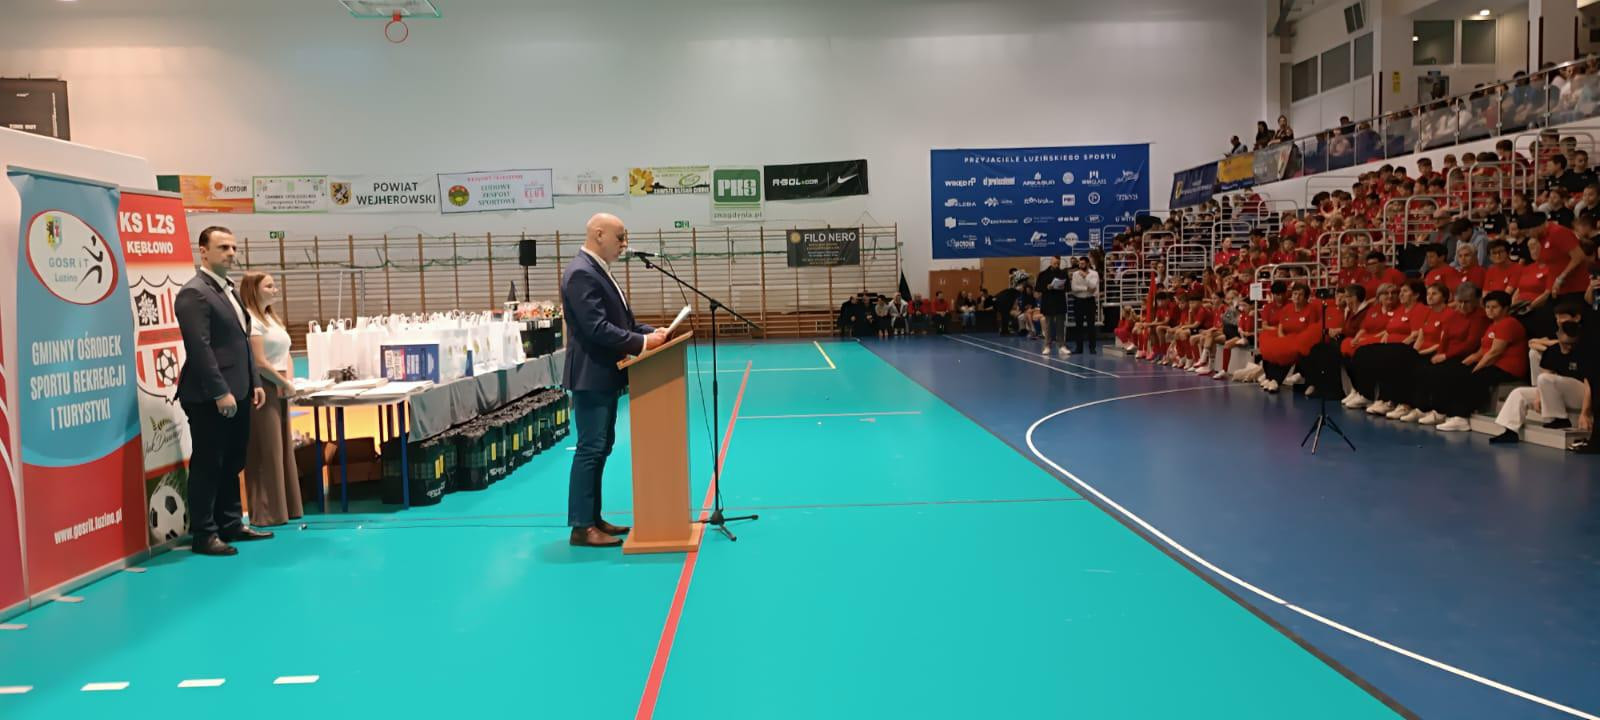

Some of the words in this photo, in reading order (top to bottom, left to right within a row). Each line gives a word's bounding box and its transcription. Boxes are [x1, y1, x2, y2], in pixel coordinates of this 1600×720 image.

[964, 156, 1020, 164] PRZYJACIELE
[1083, 152, 1117, 160] SPORTU
[373, 182, 418, 192] POWIAT
[577, 183, 605, 193] KLUB
[717, 178, 757, 197] PKS
[356, 194, 436, 205] WEJHEROWSKI
[119, 211, 143, 233] KS
[147, 213, 175, 235] LZS
[804, 233, 826, 243] FILO
[828, 231, 857, 242] NERO
[126, 240, 174, 256] KĘBŁOWO
[48, 257, 76, 268] GOSR
[83, 258, 89, 268] T
[54, 273, 78, 283] Luzino
[32, 339, 75, 366] GMINNY
[77, 331, 122, 360] OŚRODEK
[30, 372, 71, 400] SPORTU
[73, 365, 127, 394] REKREACJI
[51, 407, 55, 431] I
[57, 397, 111, 429] TURYSTYKI
[54, 507, 122, 544] www.gosrit.luzino.pl
